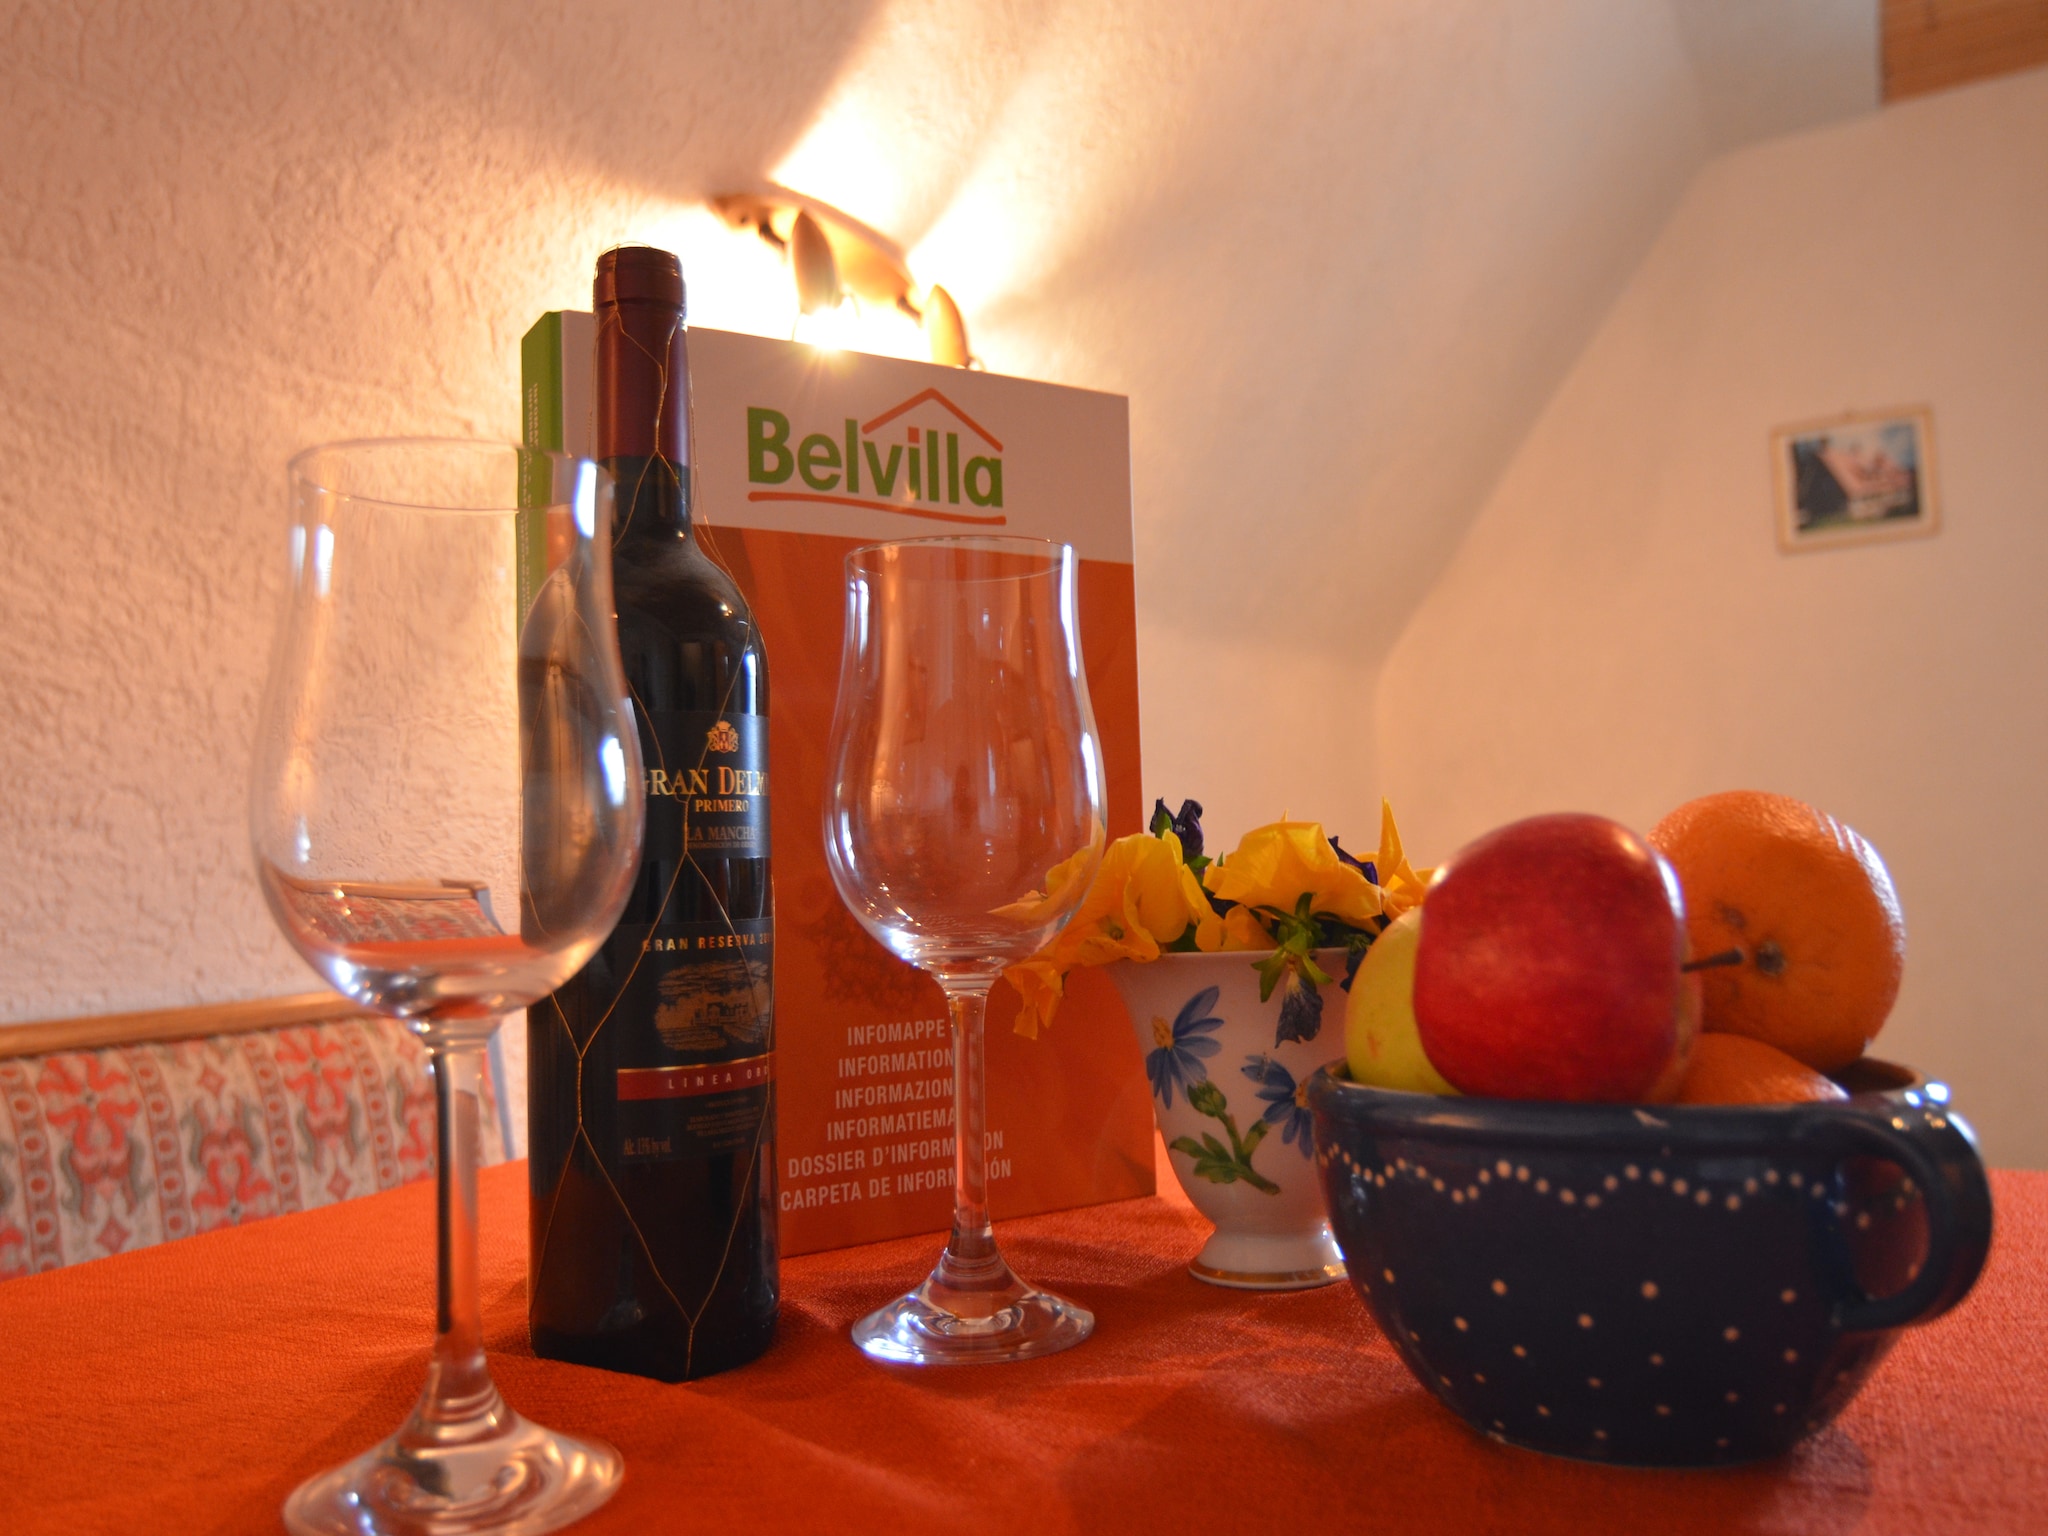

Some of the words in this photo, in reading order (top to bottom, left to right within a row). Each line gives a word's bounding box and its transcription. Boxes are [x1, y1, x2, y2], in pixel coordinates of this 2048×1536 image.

[746, 405, 1004, 508] Belvilla
[695, 799, 749, 813] PRIMERO
[641, 937, 689, 951] GRAN
[698, 933, 756, 949] RESERVA
[847, 1019, 946, 1046] INFOMAPPE
[838, 1048, 955, 1078] INFORMATION
[668, 1072, 732, 1089] LINEA
[835, 1078, 954, 1109] INFORMAZION
[827, 1107, 957, 1141] INFORMATIEMA
[788, 1148, 866, 1178] DOSSIER
[872, 1130, 1004, 1167] D'INFORMON
[780, 1182, 862, 1211] CARPETA
[868, 1177, 891, 1199] DE
[897, 1156, 1012, 1195] INFORMIÓN
